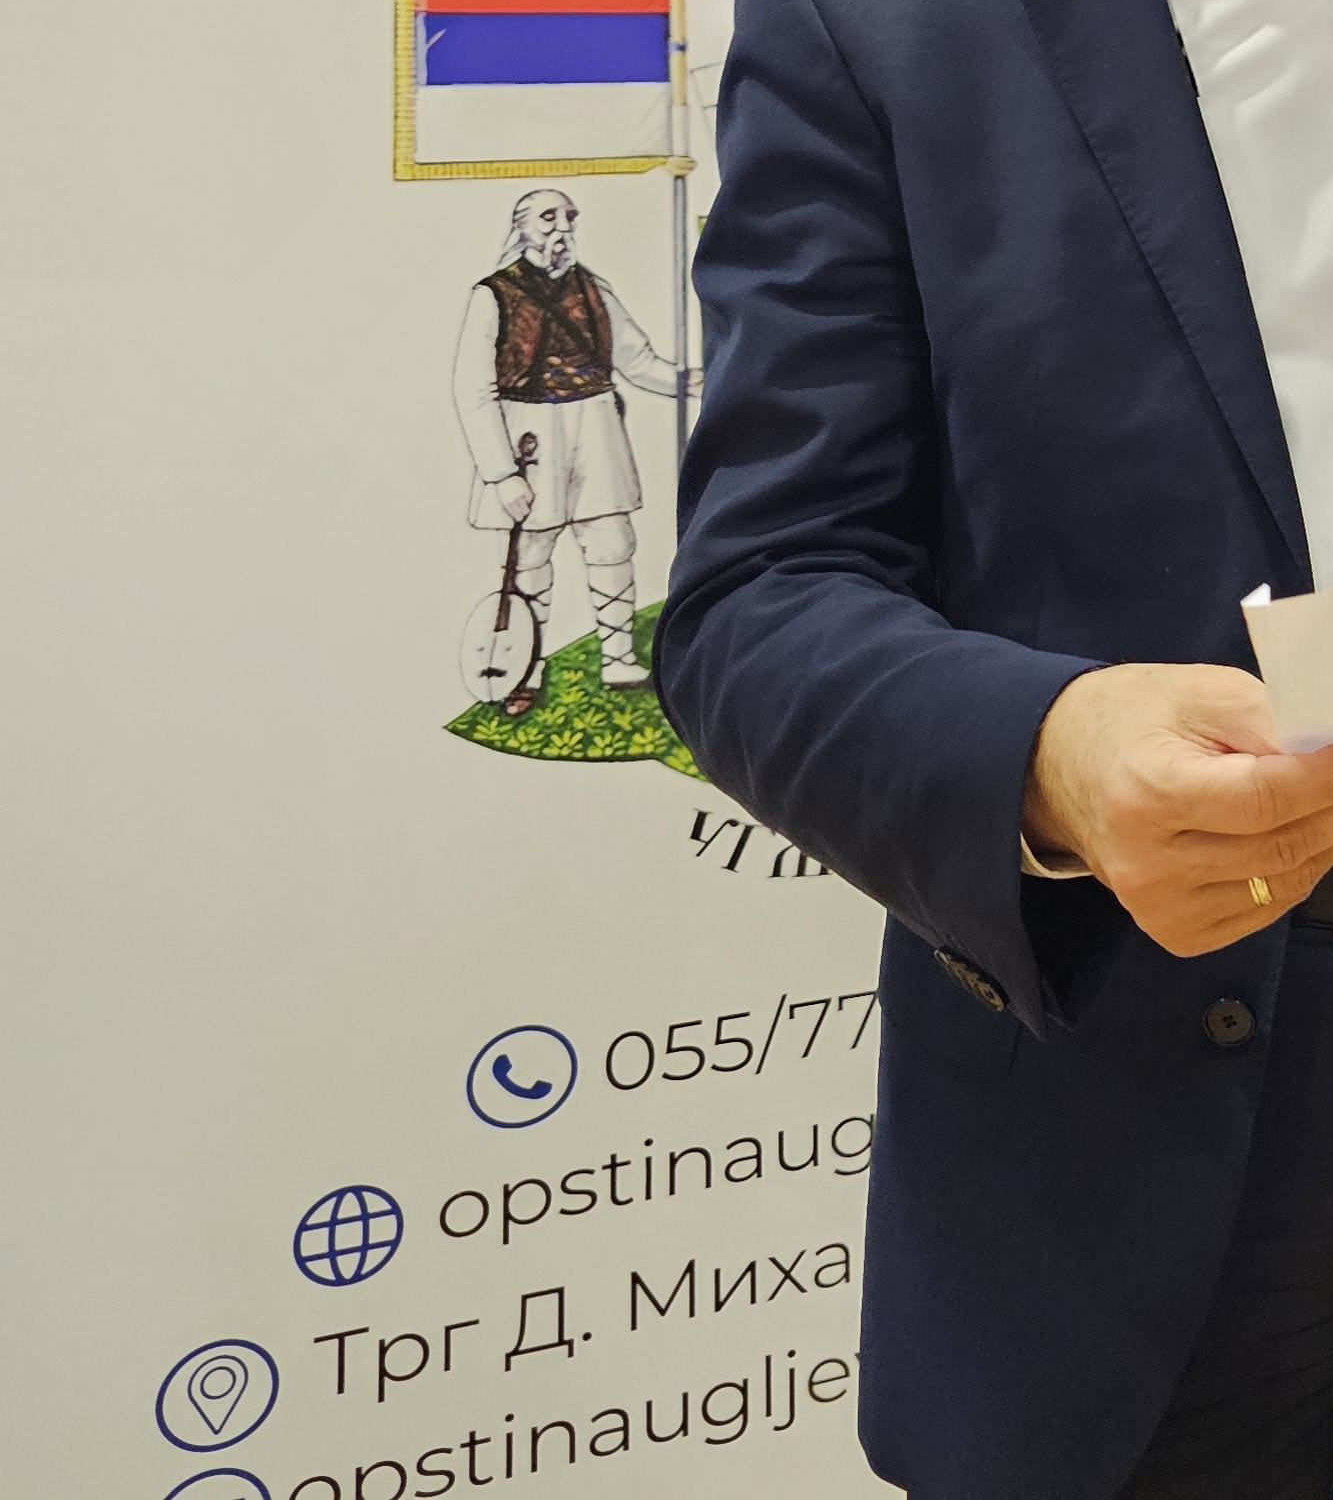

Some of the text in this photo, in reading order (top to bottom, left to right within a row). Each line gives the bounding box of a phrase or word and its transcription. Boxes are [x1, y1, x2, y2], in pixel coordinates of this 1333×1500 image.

[605, 990, 878, 1091] 055/77
[439, 1112, 875, 1246] opstinaug
[313, 1242, 851, 1404] Трг Д. Миха
[289, 1349, 861, 1500] opstinauglje
